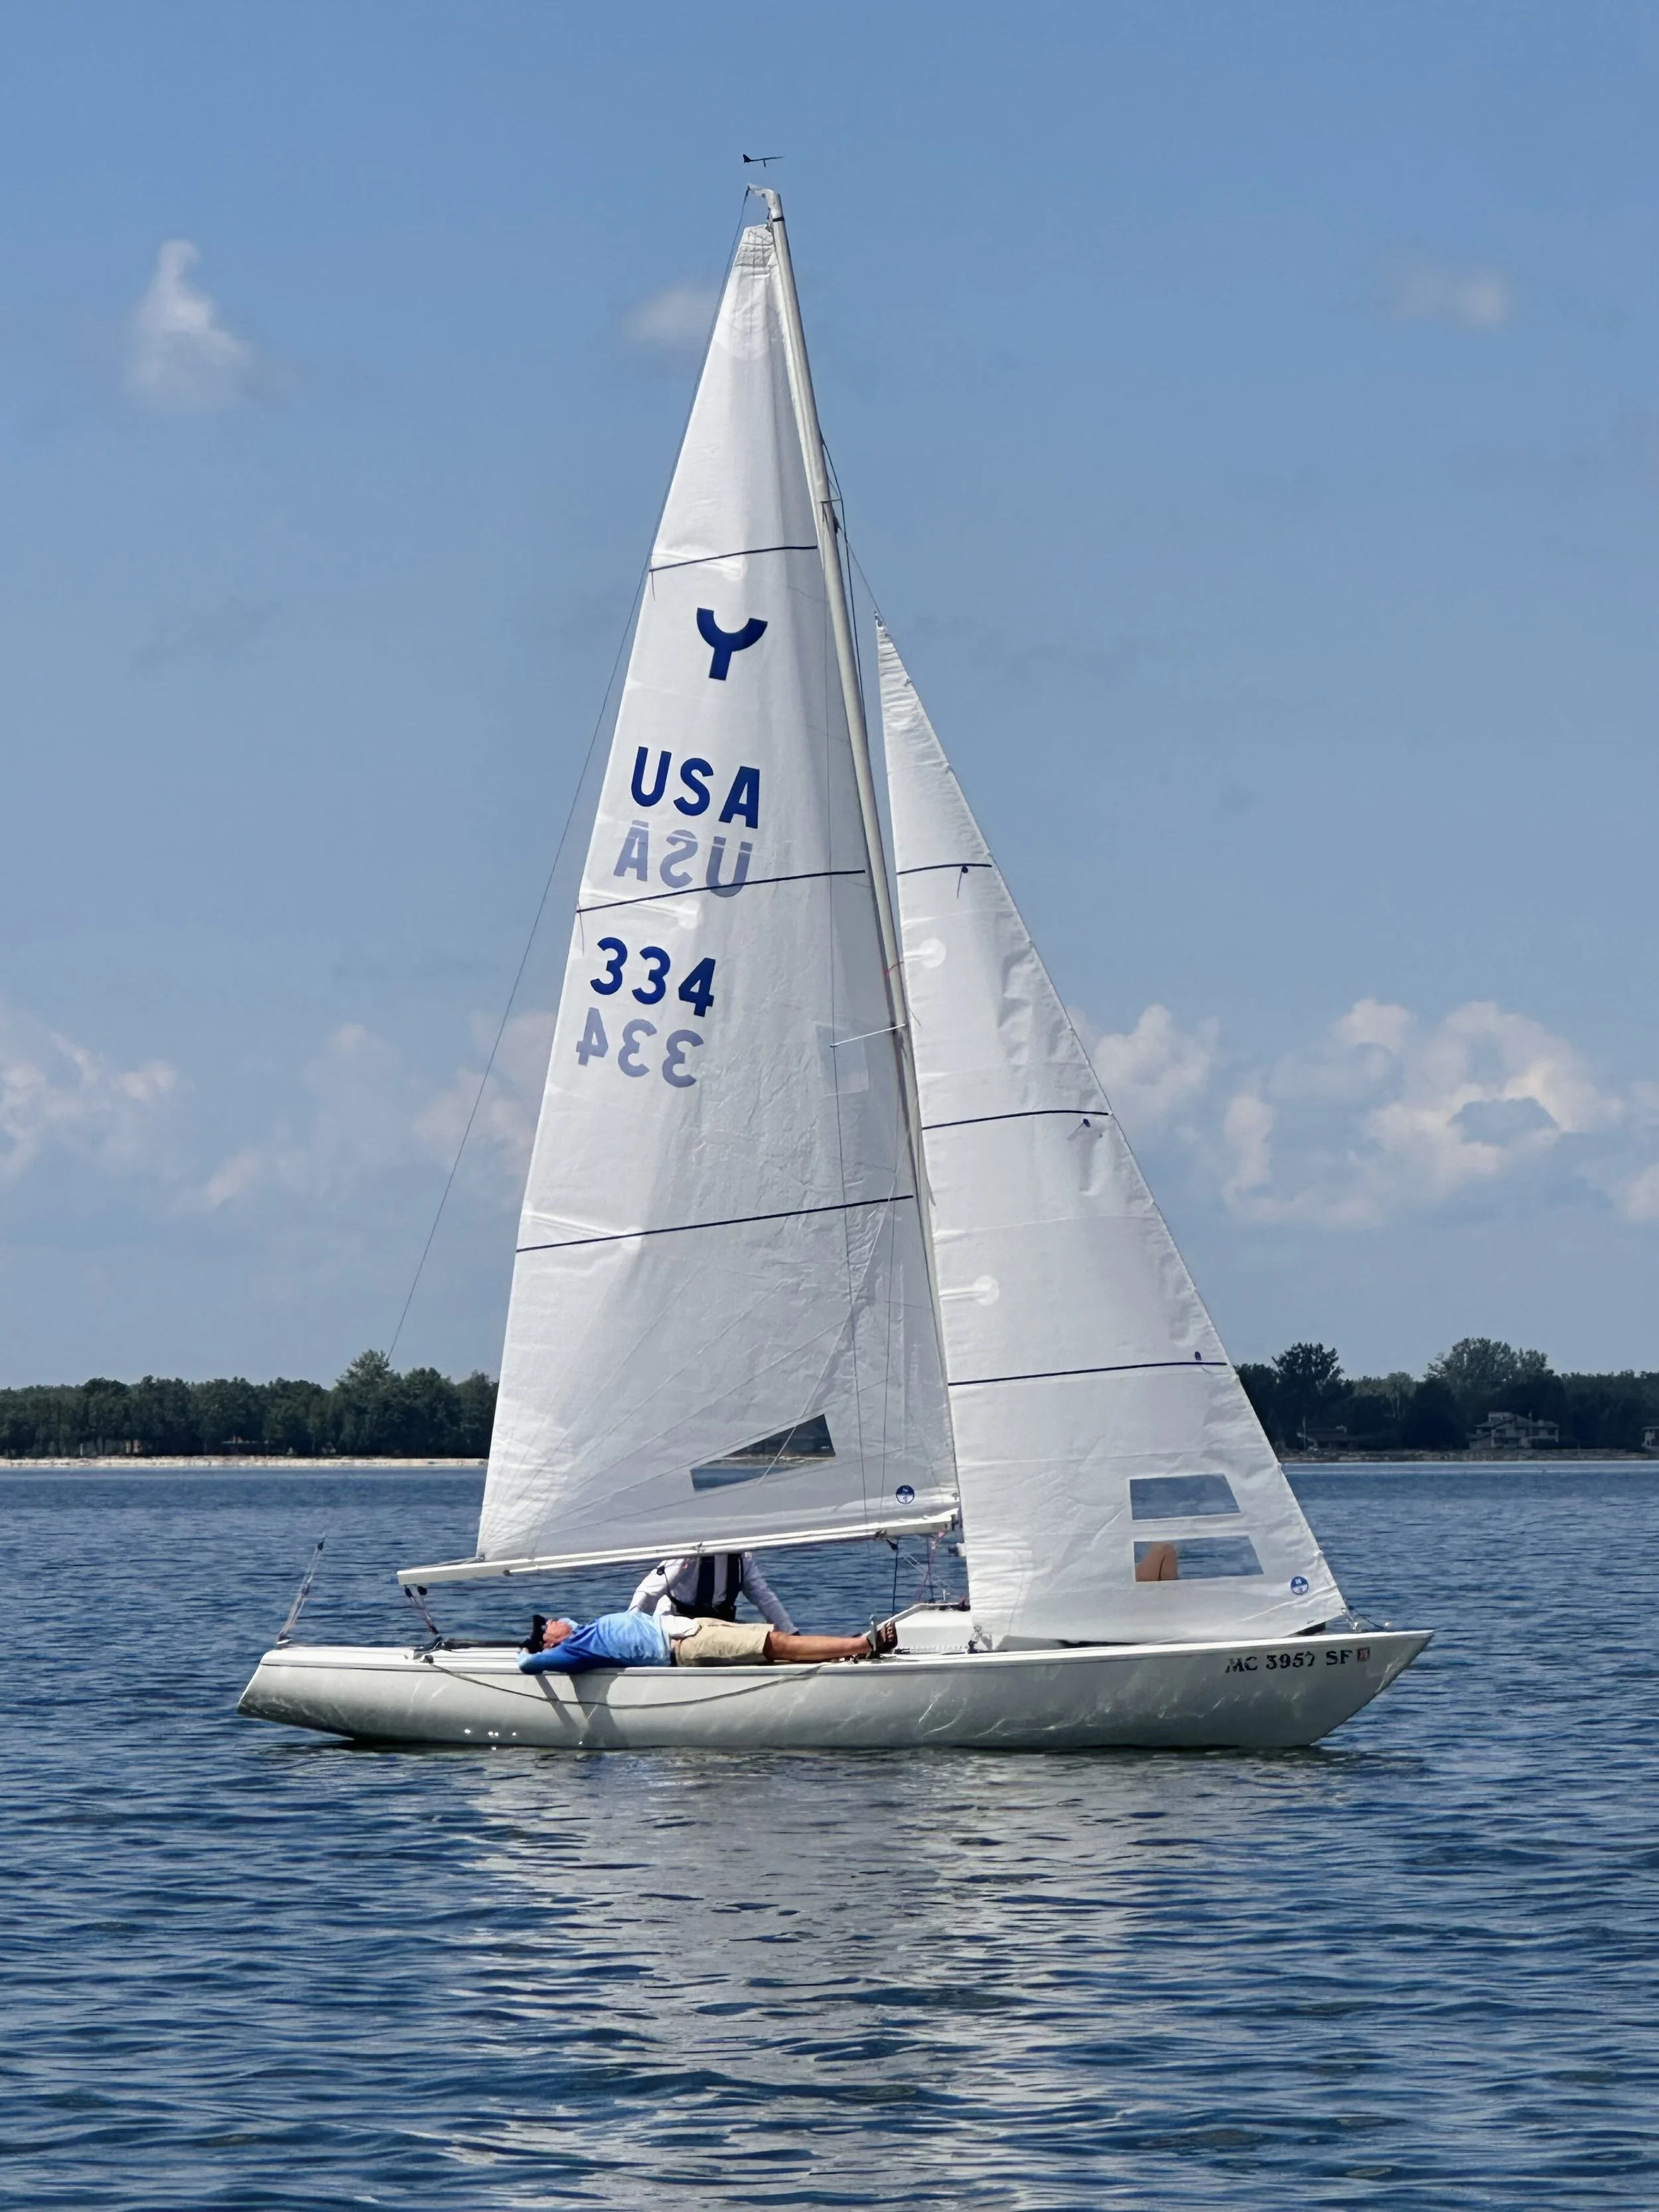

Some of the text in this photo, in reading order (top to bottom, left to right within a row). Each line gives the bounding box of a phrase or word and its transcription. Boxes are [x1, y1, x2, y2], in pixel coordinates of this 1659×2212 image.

[696, 607, 768, 681] Y
[630, 746, 761, 830] USA
[590, 936, 716, 1017] 334
[1225, 1656, 1258, 1674] MC
[1325, 1649, 1353, 1666] SF
